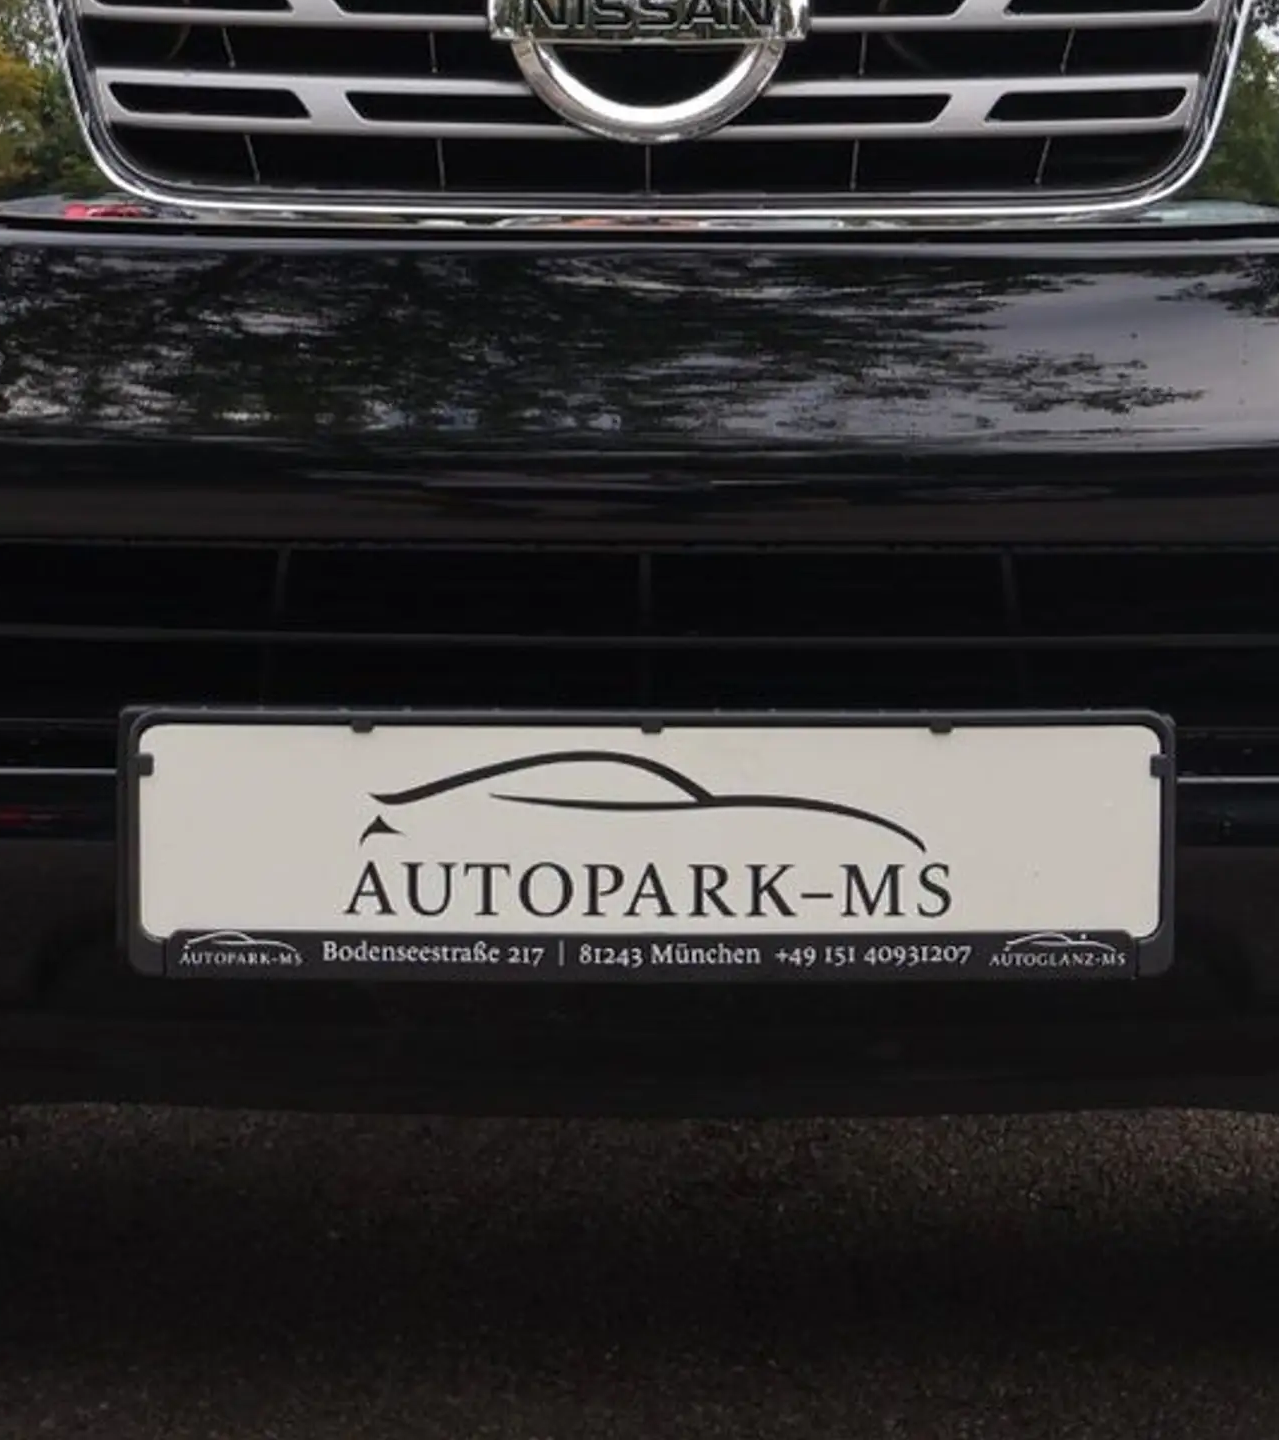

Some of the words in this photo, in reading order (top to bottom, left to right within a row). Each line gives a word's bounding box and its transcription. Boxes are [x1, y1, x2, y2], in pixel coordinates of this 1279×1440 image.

[343, 860, 953, 918] AUTOPARK-MS
[322, 940, 500, 963] Bodenseestraße
[507, 947, 546, 967] 217
[578, 943, 644, 968] 81243
[650, 942, 762, 965] München
[774, 946, 817, 967] +49
[824, 945, 857, 967] 151
[863, 944, 973, 967] 40931207
